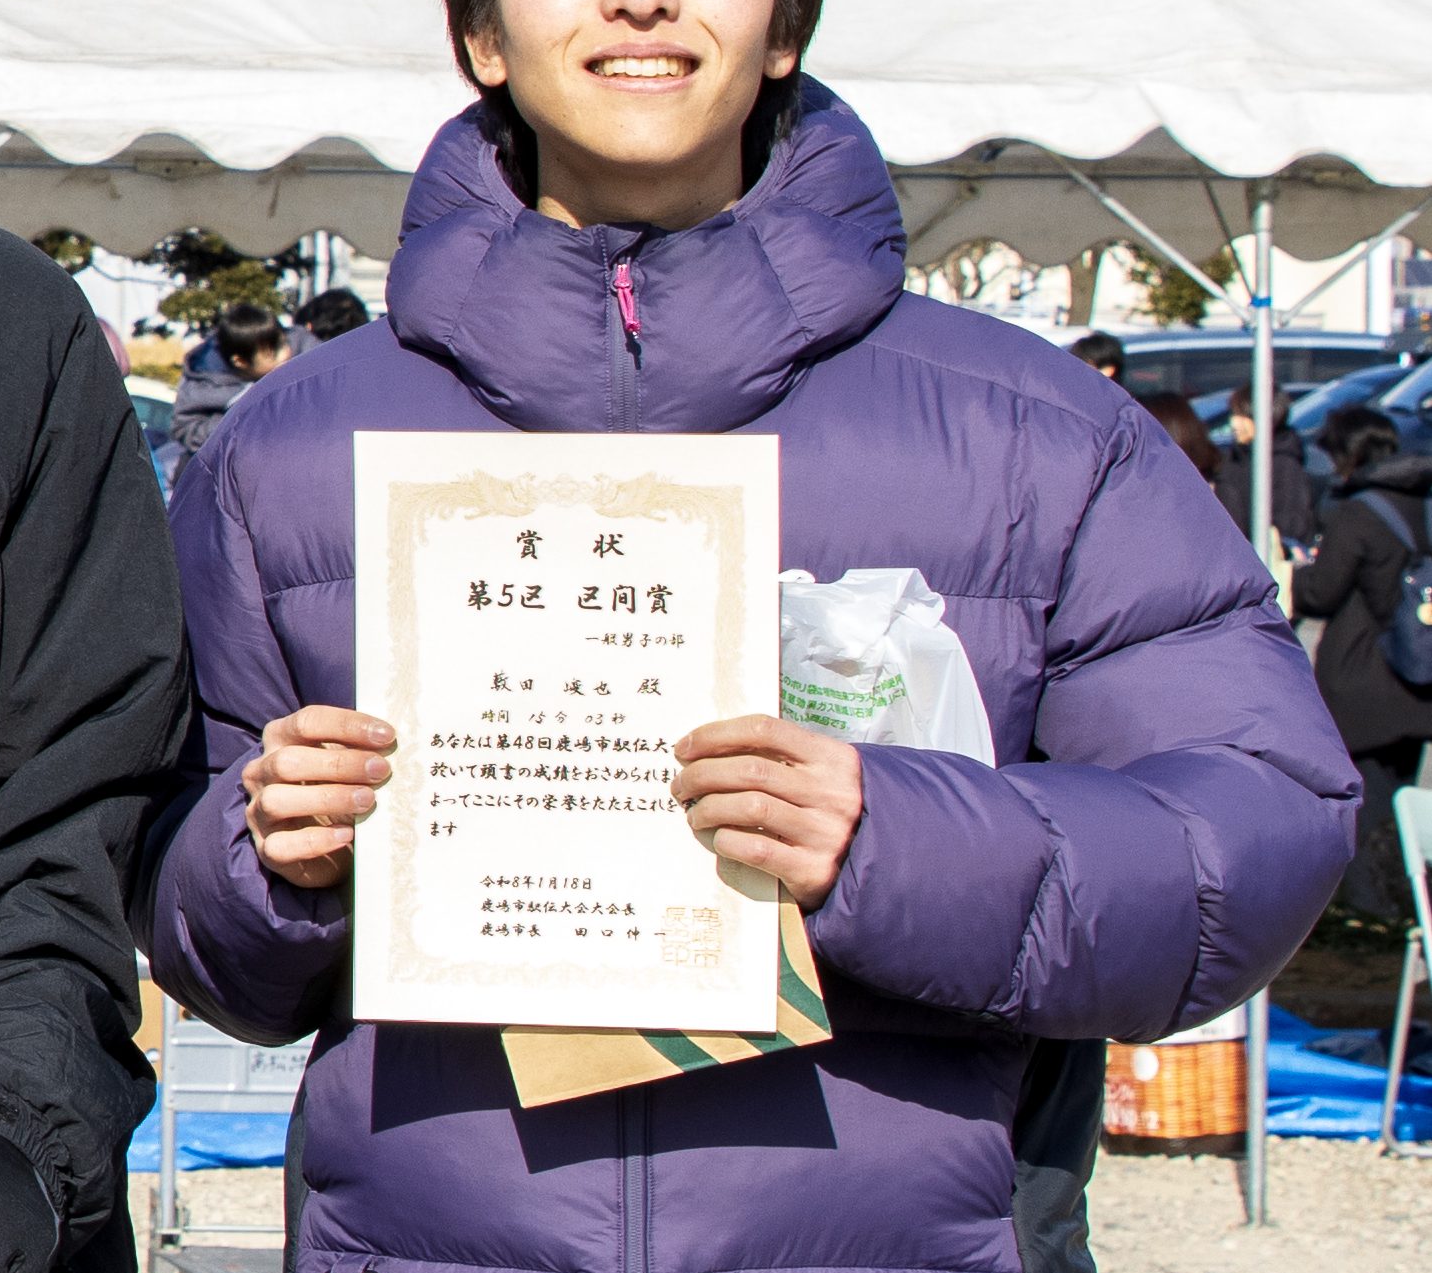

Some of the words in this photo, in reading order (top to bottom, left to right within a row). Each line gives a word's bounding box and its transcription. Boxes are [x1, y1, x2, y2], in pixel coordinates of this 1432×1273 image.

[467, 580, 545, 611] 第5区
[577, 584, 673, 614] 区間賞
[585, 632, 685, 648] 一般男子の部
[637, 678, 661, 696] 殿
[481, 709, 509, 723] 時間
[430, 733, 675, 753] あなたは第48回鹿嶋市駅伝大
[430, 821, 457, 836] ます
[479, 875, 592, 890] 令和8年1月18日
[480, 898, 636, 916] 鹿嶋市駅伝大会大会長
[480, 922, 541, 937] 鹿嶋市長
